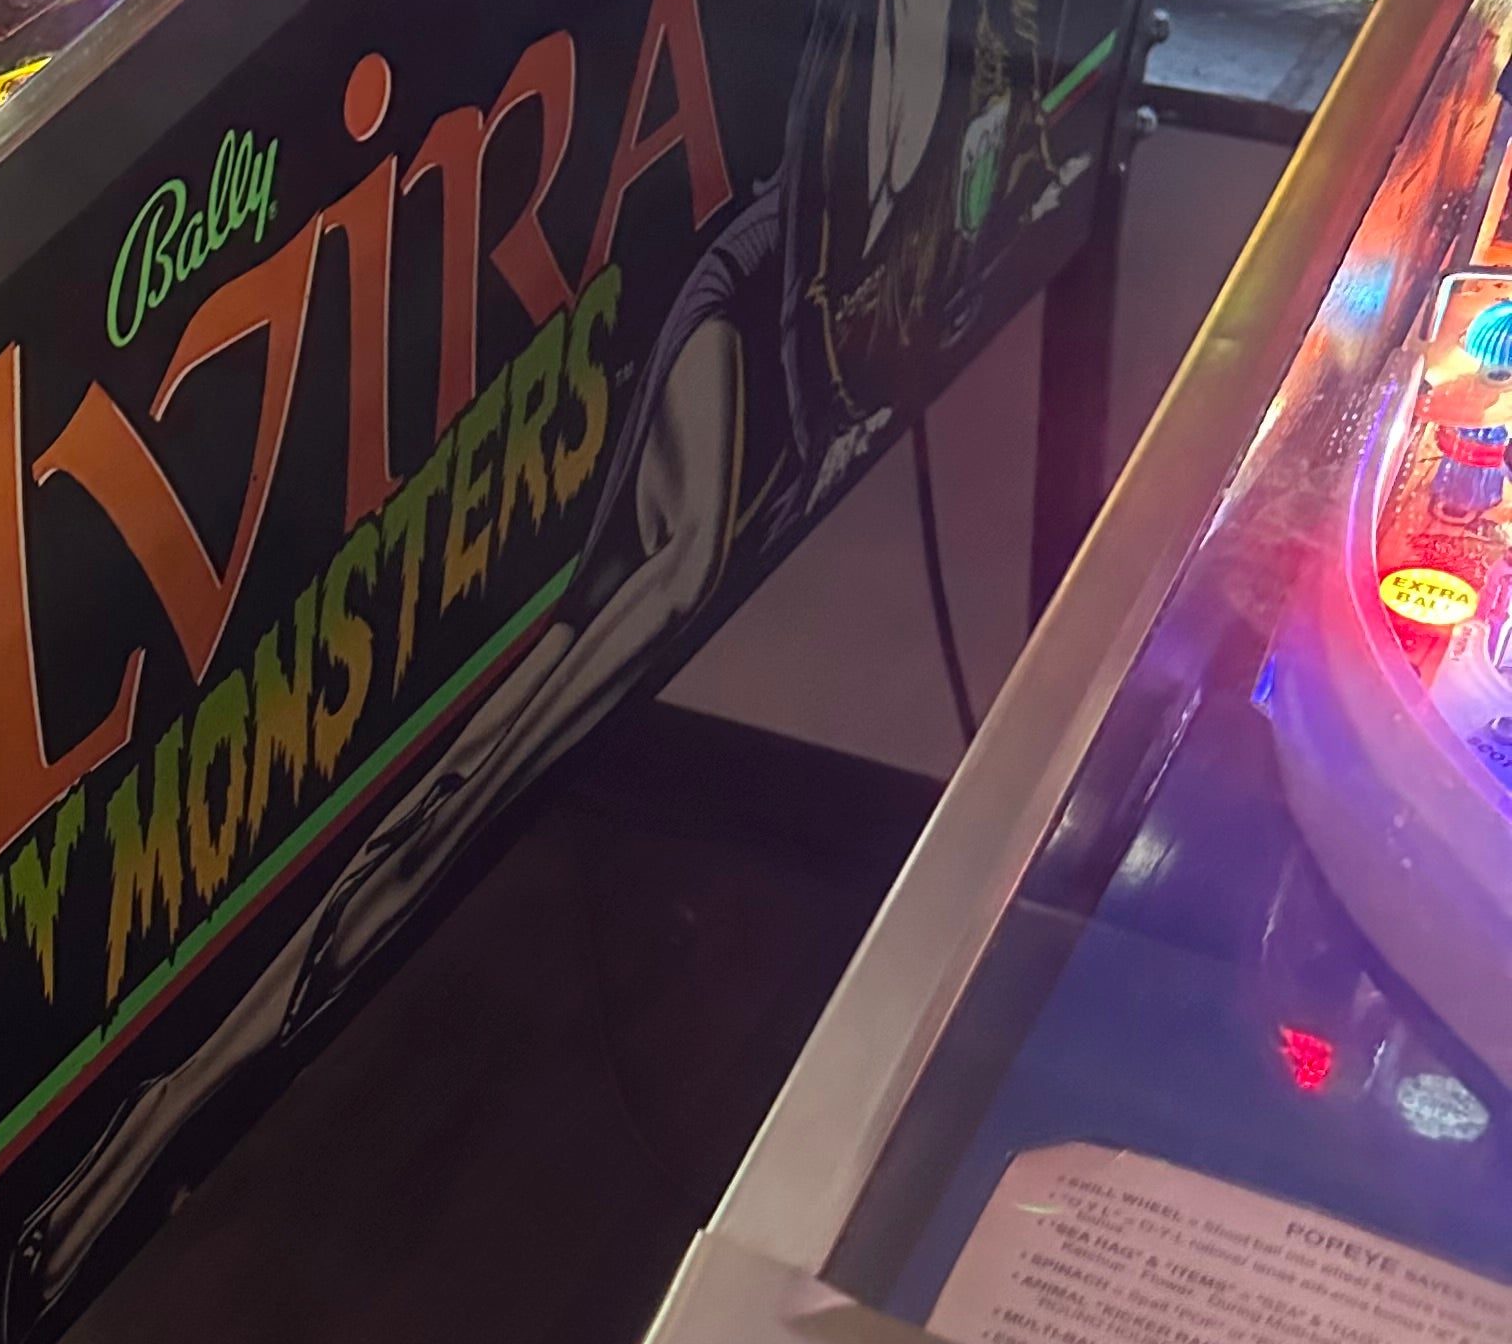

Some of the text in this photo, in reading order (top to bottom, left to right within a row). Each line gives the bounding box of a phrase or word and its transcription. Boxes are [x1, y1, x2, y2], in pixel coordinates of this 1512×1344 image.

[107, 128, 278, 348] Bally
[100, 263, 622, 1040] MONSTERS
[1392, 576, 1470, 605] EXTRA
[1286, 1222, 1399, 1275] POPEYE
